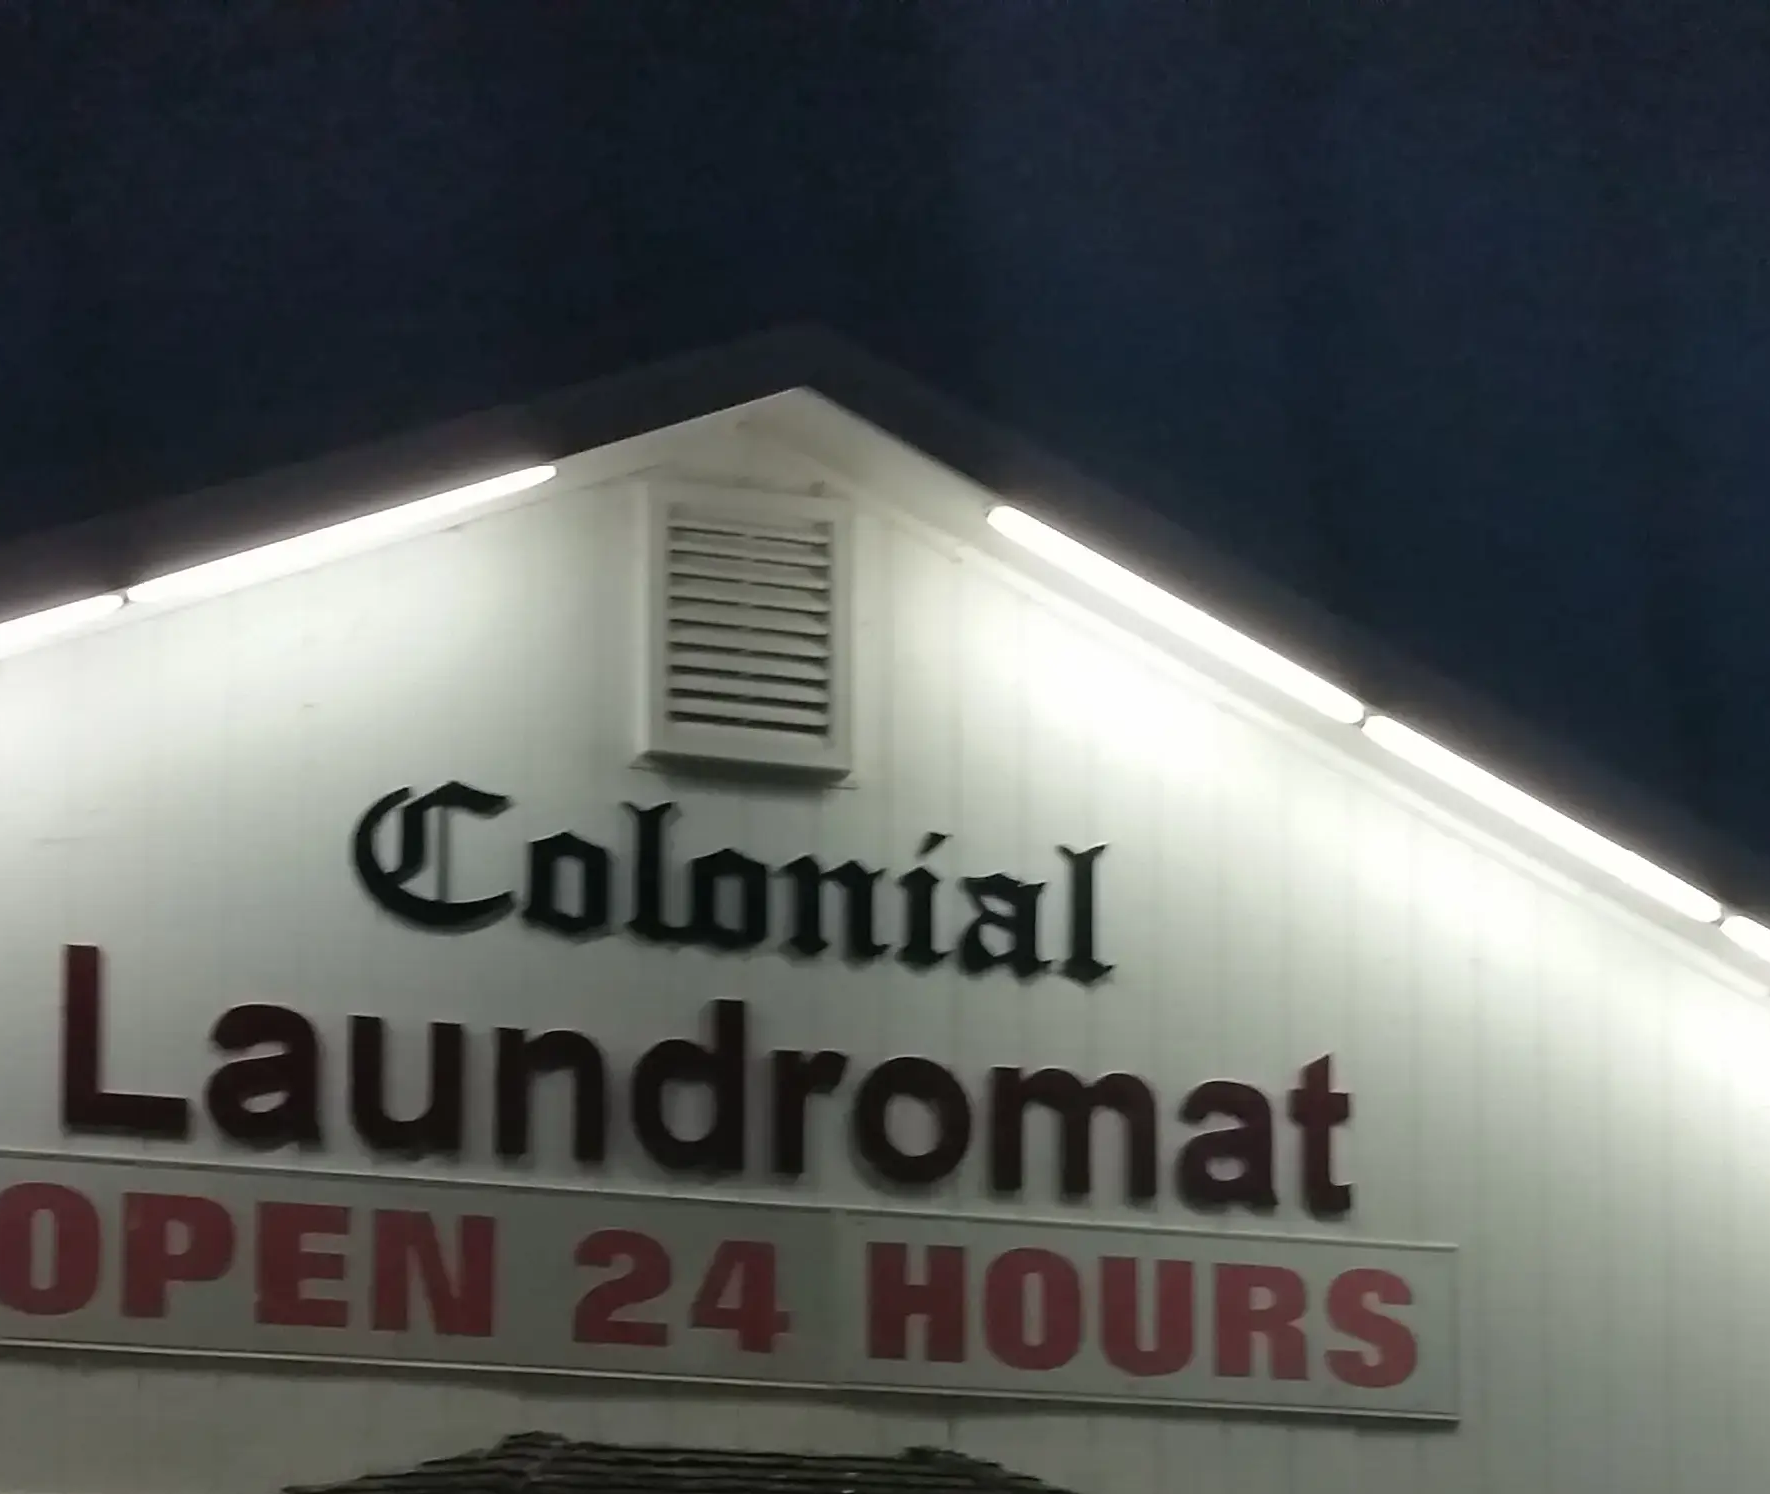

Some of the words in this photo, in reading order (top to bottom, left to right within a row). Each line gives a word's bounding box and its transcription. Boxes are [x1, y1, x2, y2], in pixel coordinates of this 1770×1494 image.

[353, 780, 1117, 986] Colonial
[61, 944, 1355, 1220] Laundromat
[573, 1228, 791, 1354] 24
[865, 1242, 1419, 1388] HOURS
